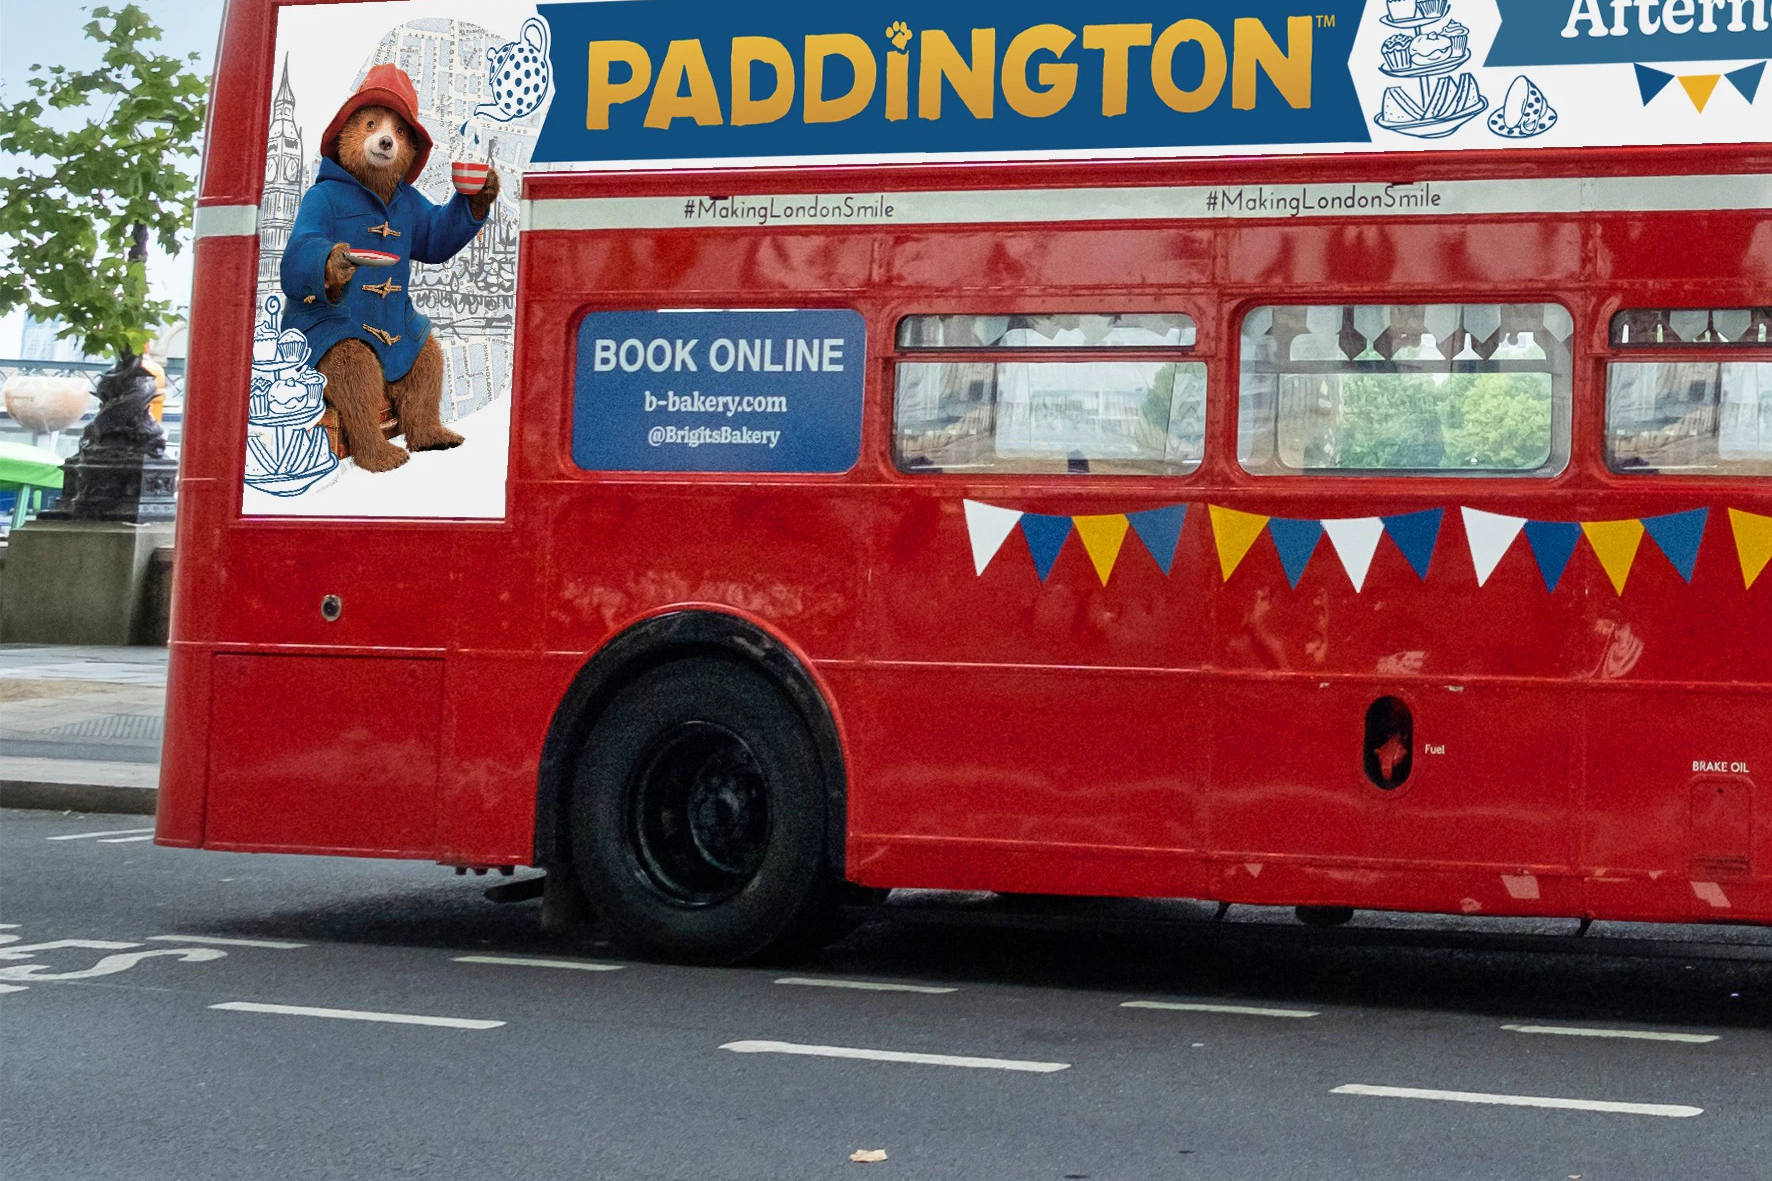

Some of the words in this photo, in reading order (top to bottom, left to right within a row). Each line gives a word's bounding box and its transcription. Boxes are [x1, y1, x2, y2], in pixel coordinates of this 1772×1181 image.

[684, 196, 894, 224] #MakingLondonSmile
[1206, 183, 1441, 217] #MakingLondonSmile
[594, 338, 698, 373] BOOK
[709, 338, 845, 373] ONLINE
[644, 390, 788, 417] b-bakery.com
[648, 425, 781, 448] @BrigitsBakery
[1425, 744, 1445, 755] Fuel
[1692, 760, 1728, 773] BRAKE
[1730, 761, 1750, 773] OIL
